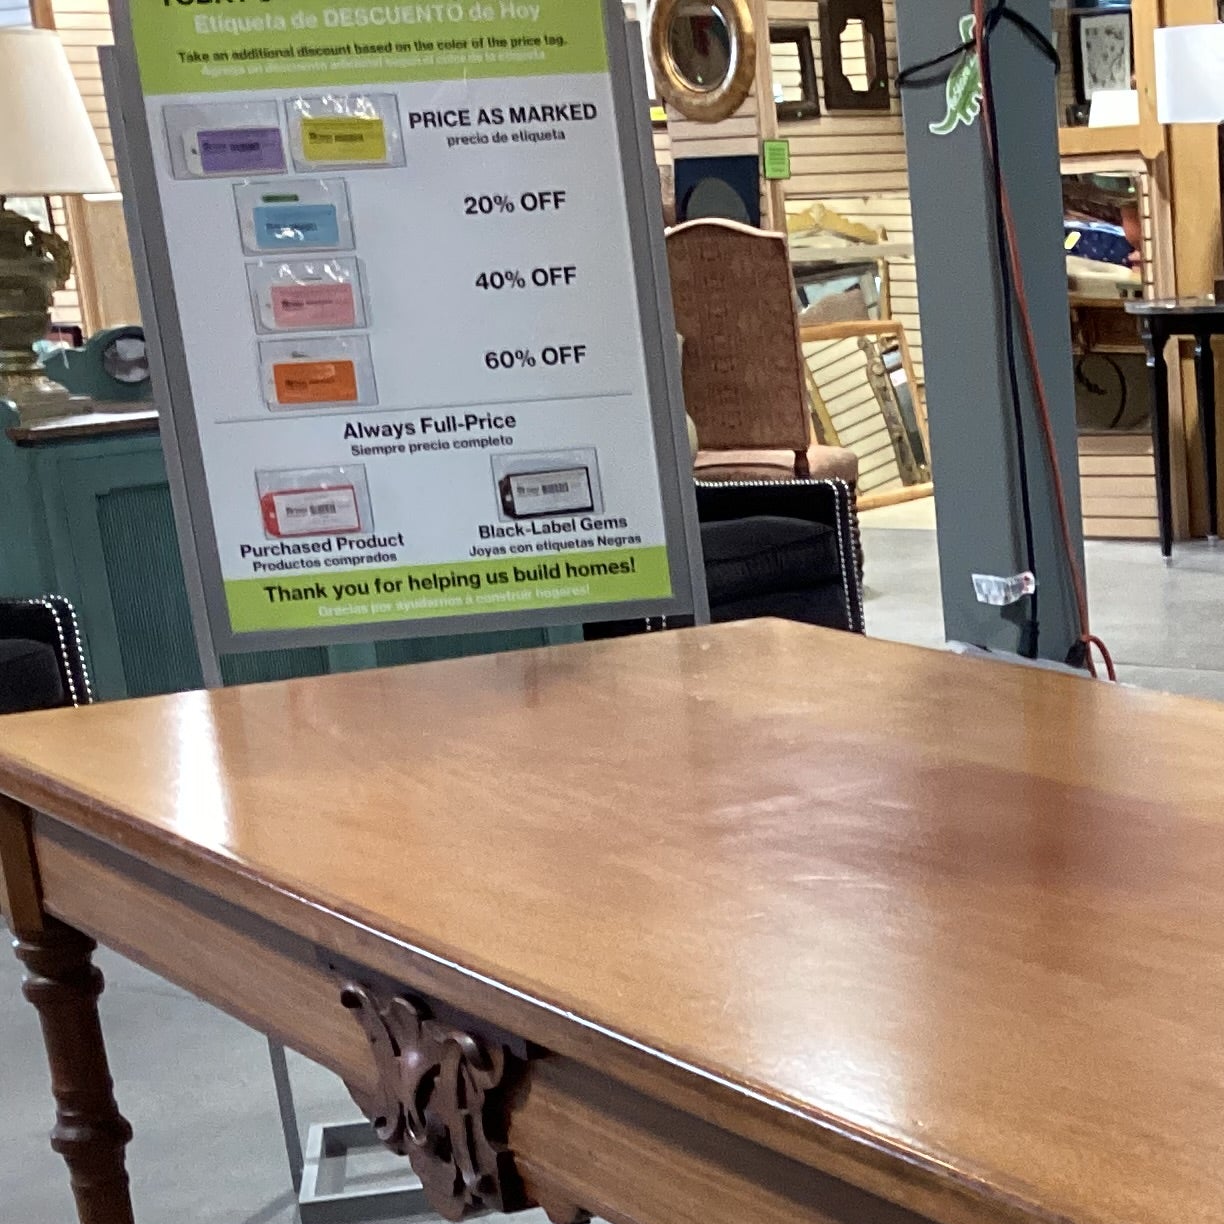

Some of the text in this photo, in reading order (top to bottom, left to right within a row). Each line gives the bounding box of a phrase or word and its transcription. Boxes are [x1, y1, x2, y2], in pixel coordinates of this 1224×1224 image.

[194, 2, 540, 35] Etiqueta de DESCUENTO de Hoy
[178, 34, 567, 63] Take an additional discount based on the color of the price tag.
[409, 103, 597, 129] PRICE AS MARKED
[447, 129, 565, 147] precio de etiqueta
[464, 191, 566, 215] 20% OFF
[475, 266, 577, 290] 40% OFF
[485, 345, 587, 370] 60% OFF
[343, 412, 517, 440] Always Full-Price
[351, 435, 514, 460] Siempre precio completo
[478, 517, 628, 540] Black-Label Gems
[240, 532, 405, 558] Purchased Product
[469, 533, 642, 558] Joyas con etiquetas Negras
[253, 551, 398, 572] Productos comprados
[264, 556, 636, 602] Thank you for helping us build homes!
